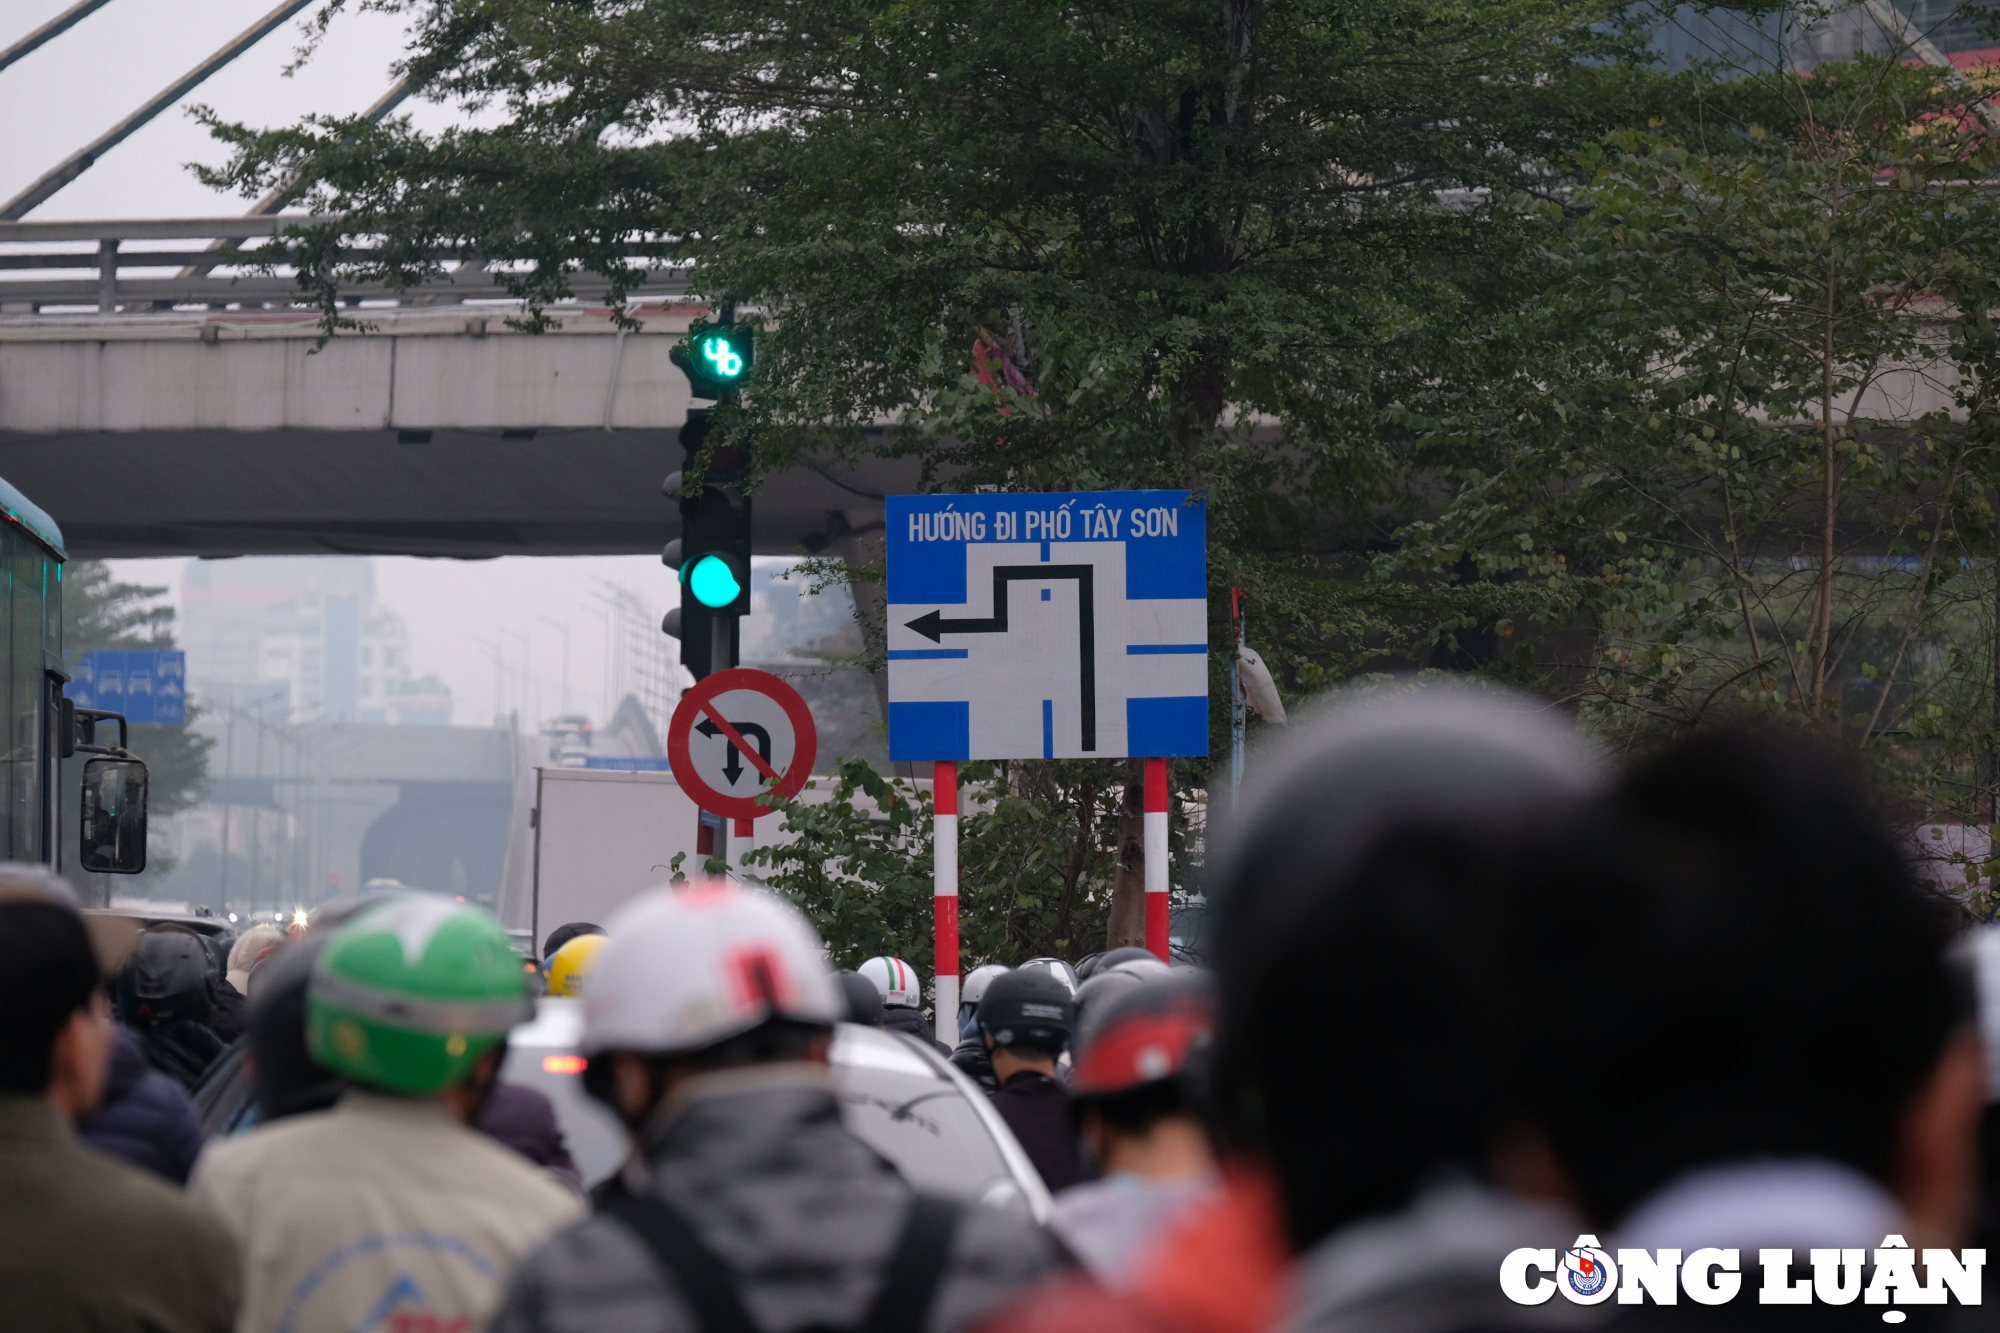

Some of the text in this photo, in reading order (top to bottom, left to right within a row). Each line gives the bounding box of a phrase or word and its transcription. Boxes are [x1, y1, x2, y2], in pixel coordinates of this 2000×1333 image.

[908, 499, 1178, 542] HƯỚNG ĐI PHỐ TÂY SƠN
